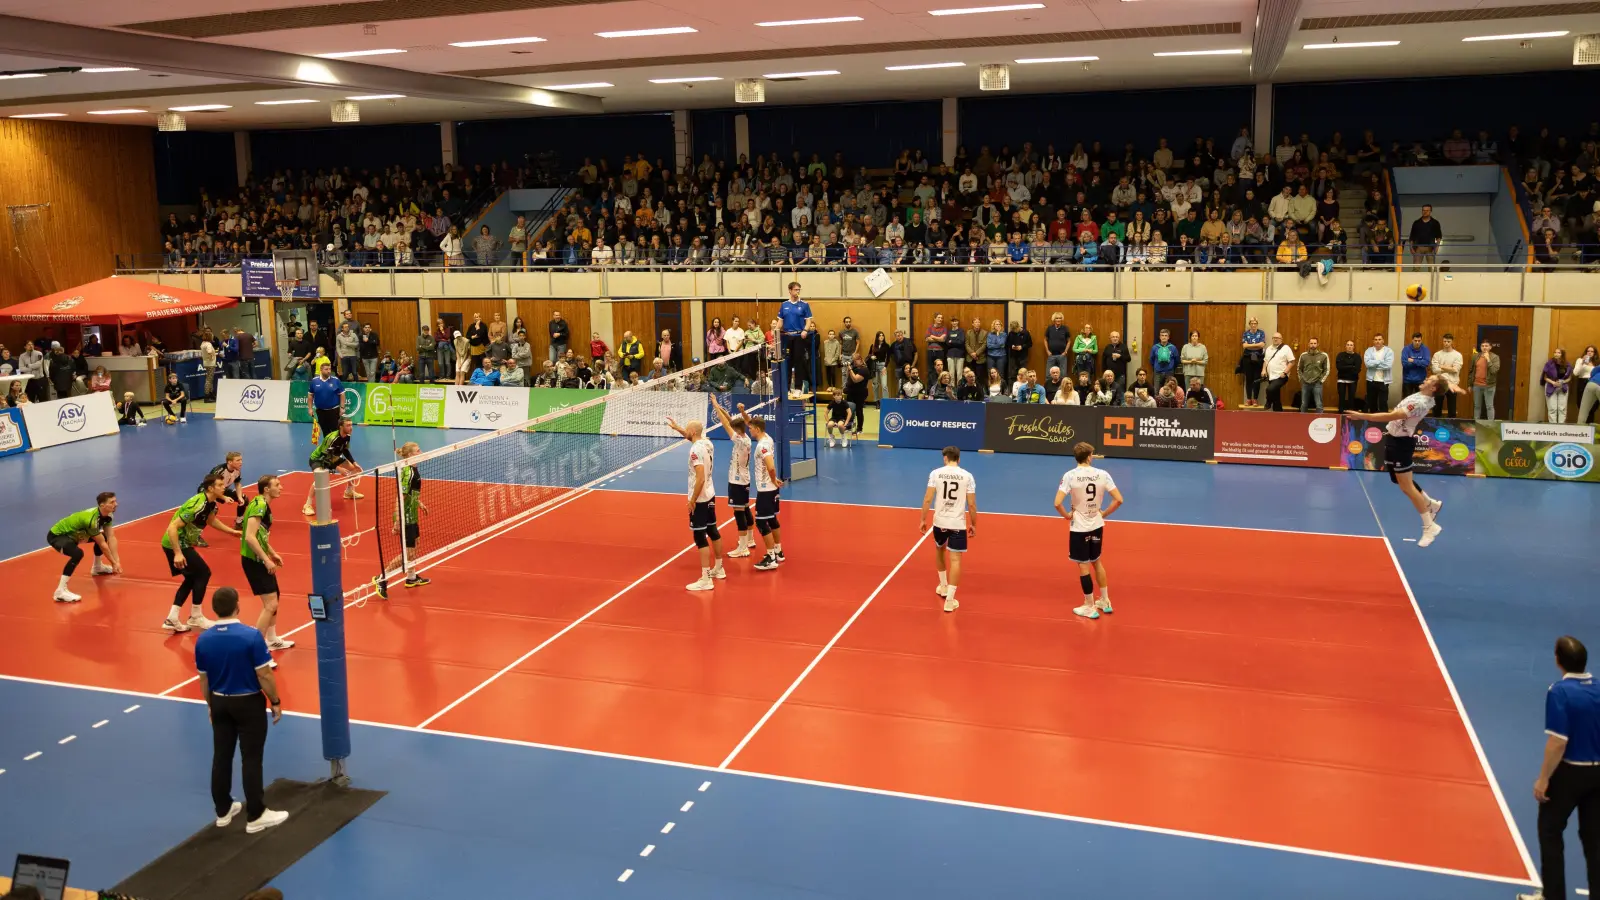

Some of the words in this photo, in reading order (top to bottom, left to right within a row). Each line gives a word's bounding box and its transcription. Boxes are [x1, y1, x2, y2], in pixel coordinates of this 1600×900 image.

[145, 308, 183, 318] BRAUEREI
[185, 303, 218, 312] KÜHBACH
[12, 314, 49, 322] BRAUEREI
[240, 389, 266, 403] ASV
[58, 405, 85, 426] ASV
[1139, 416, 1180, 428] HÖRL+
[906, 419, 929, 427] HOME
[942, 421, 977, 429] RESPECT
[1139, 427, 1208, 439] HARTMANN
[1559, 430, 1590, 438] schmeckt.
[1551, 452, 1587, 468] bio
[943, 480, 959, 500] 12
[1085, 482, 1097, 502] 9
